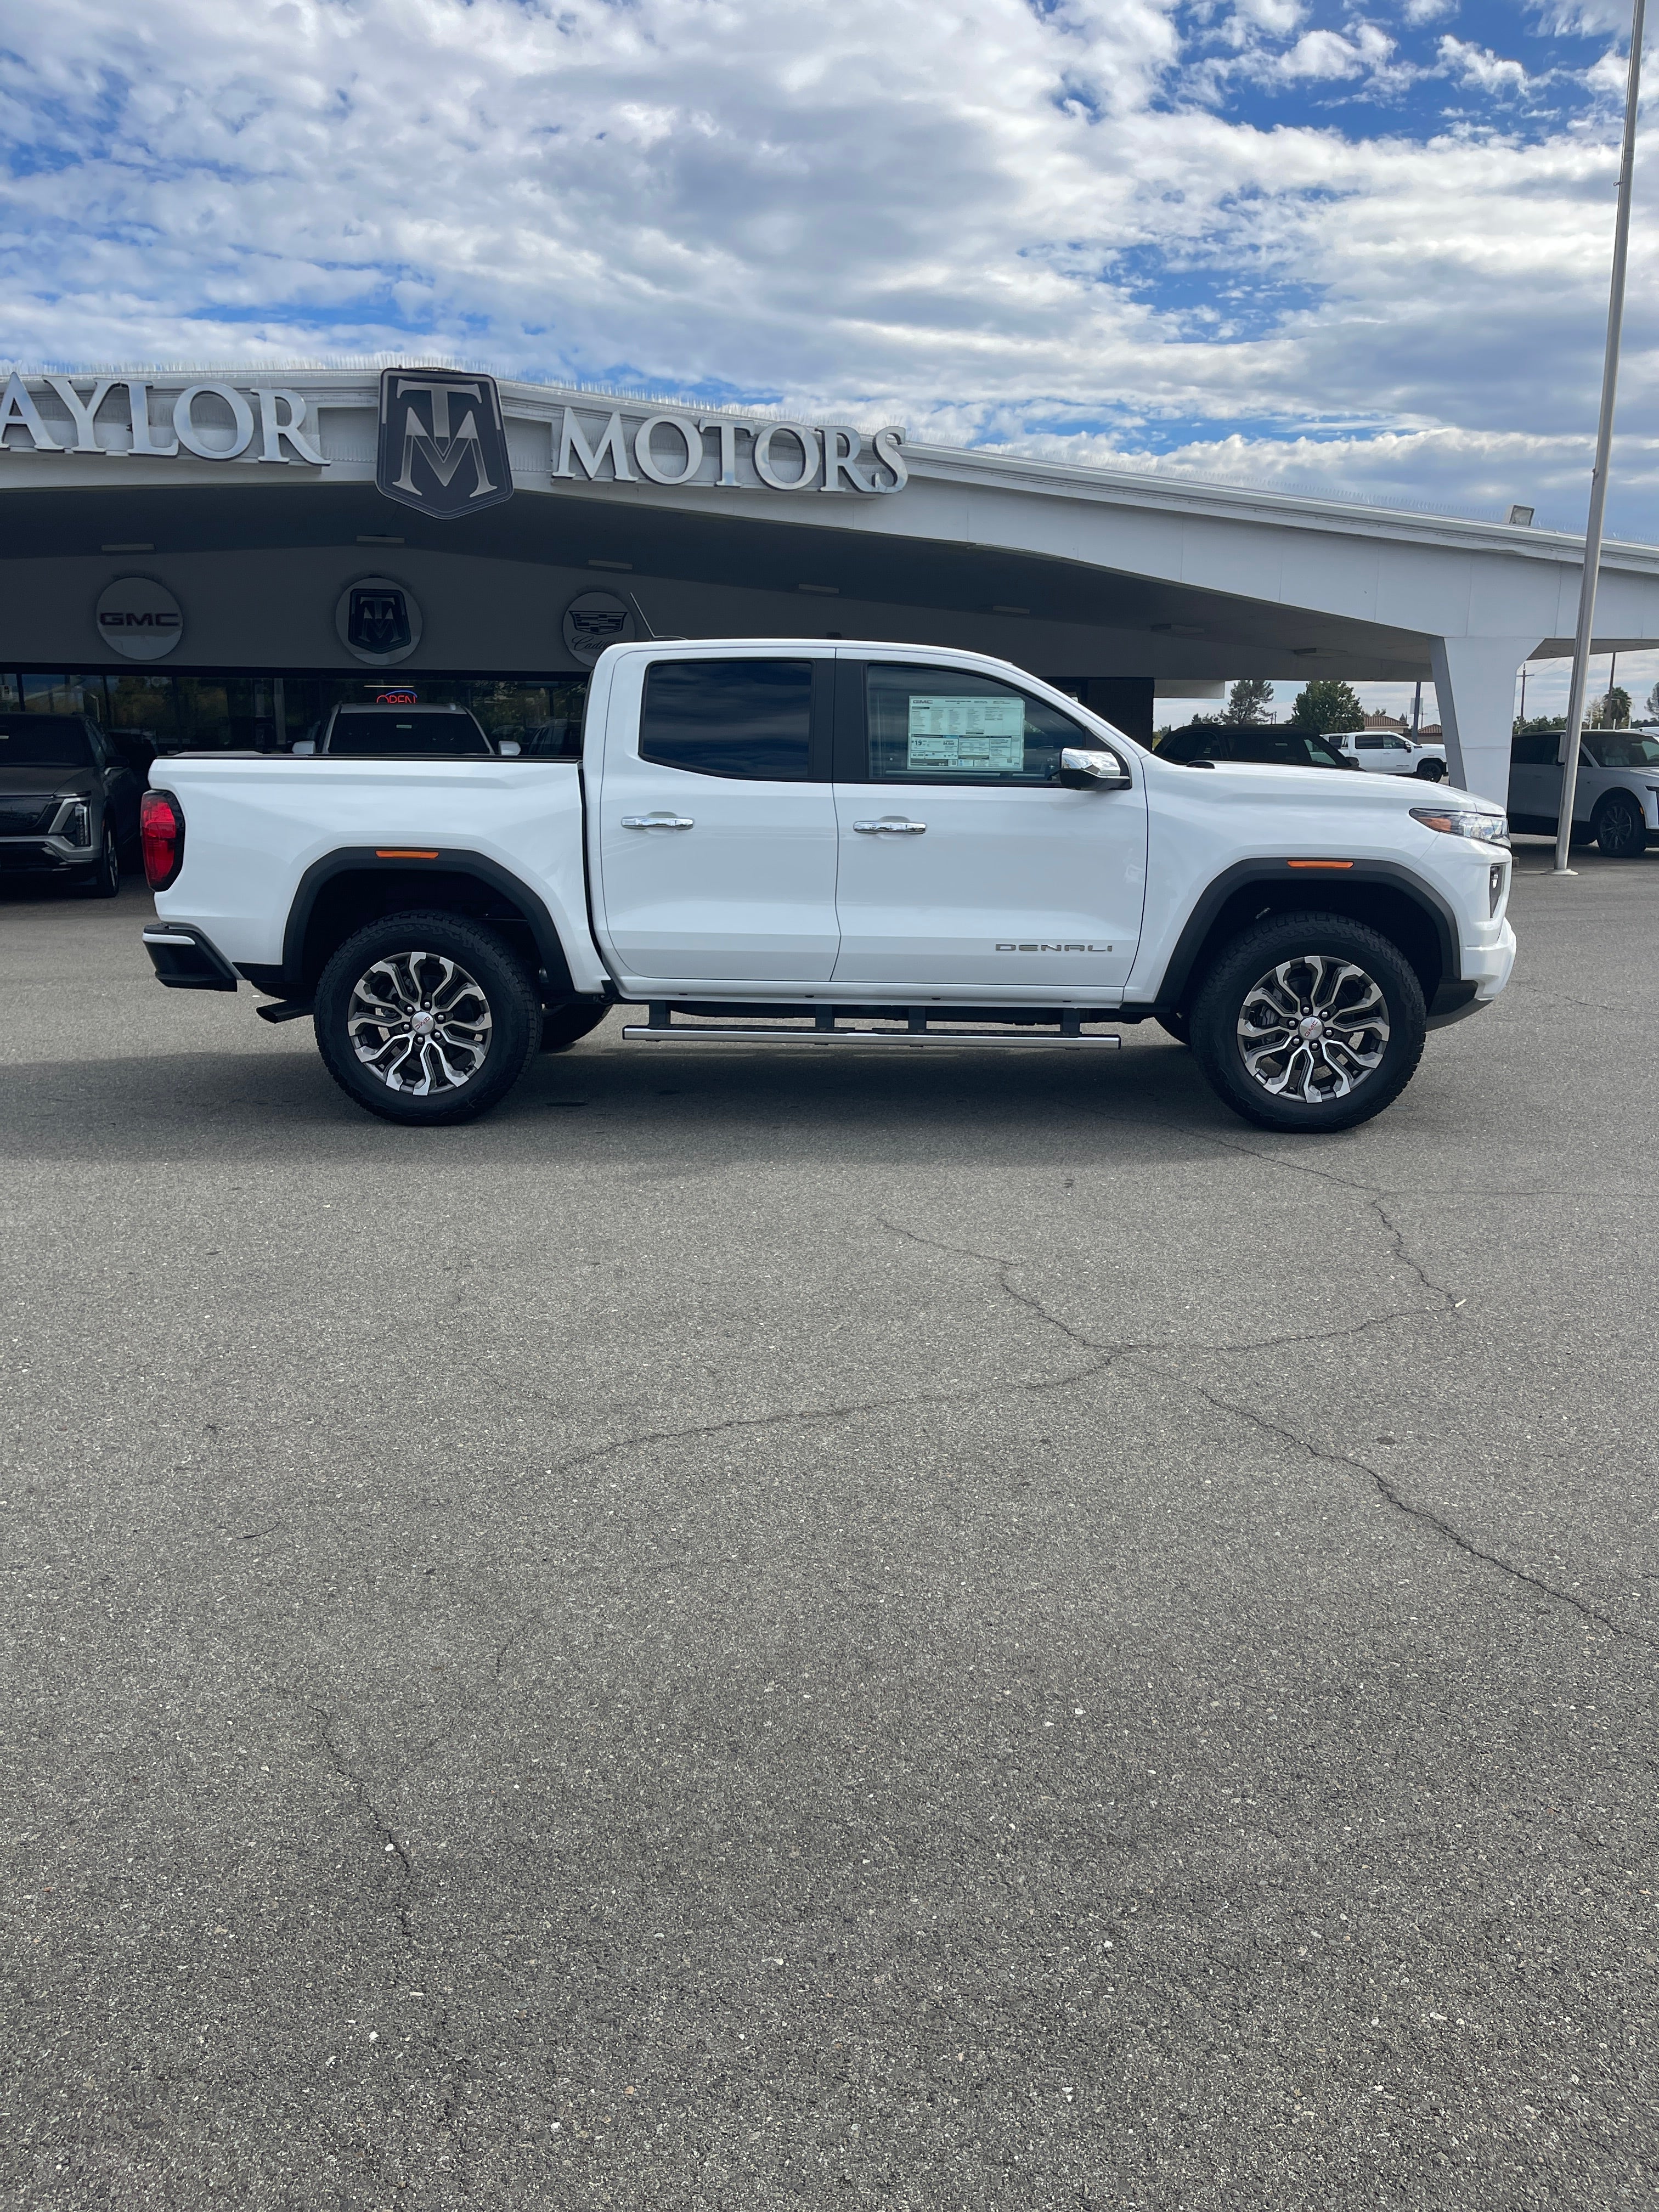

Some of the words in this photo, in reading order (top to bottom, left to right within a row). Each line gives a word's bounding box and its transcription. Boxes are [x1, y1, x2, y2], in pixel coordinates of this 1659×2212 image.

[552, 405, 910, 494] MOTORS
[100, 612, 179, 627] GMC
[996, 943, 1113, 952] DENALI
[415, 1016, 430, 1030] GMC
[1305, 1020, 1318, 1037] GMC
